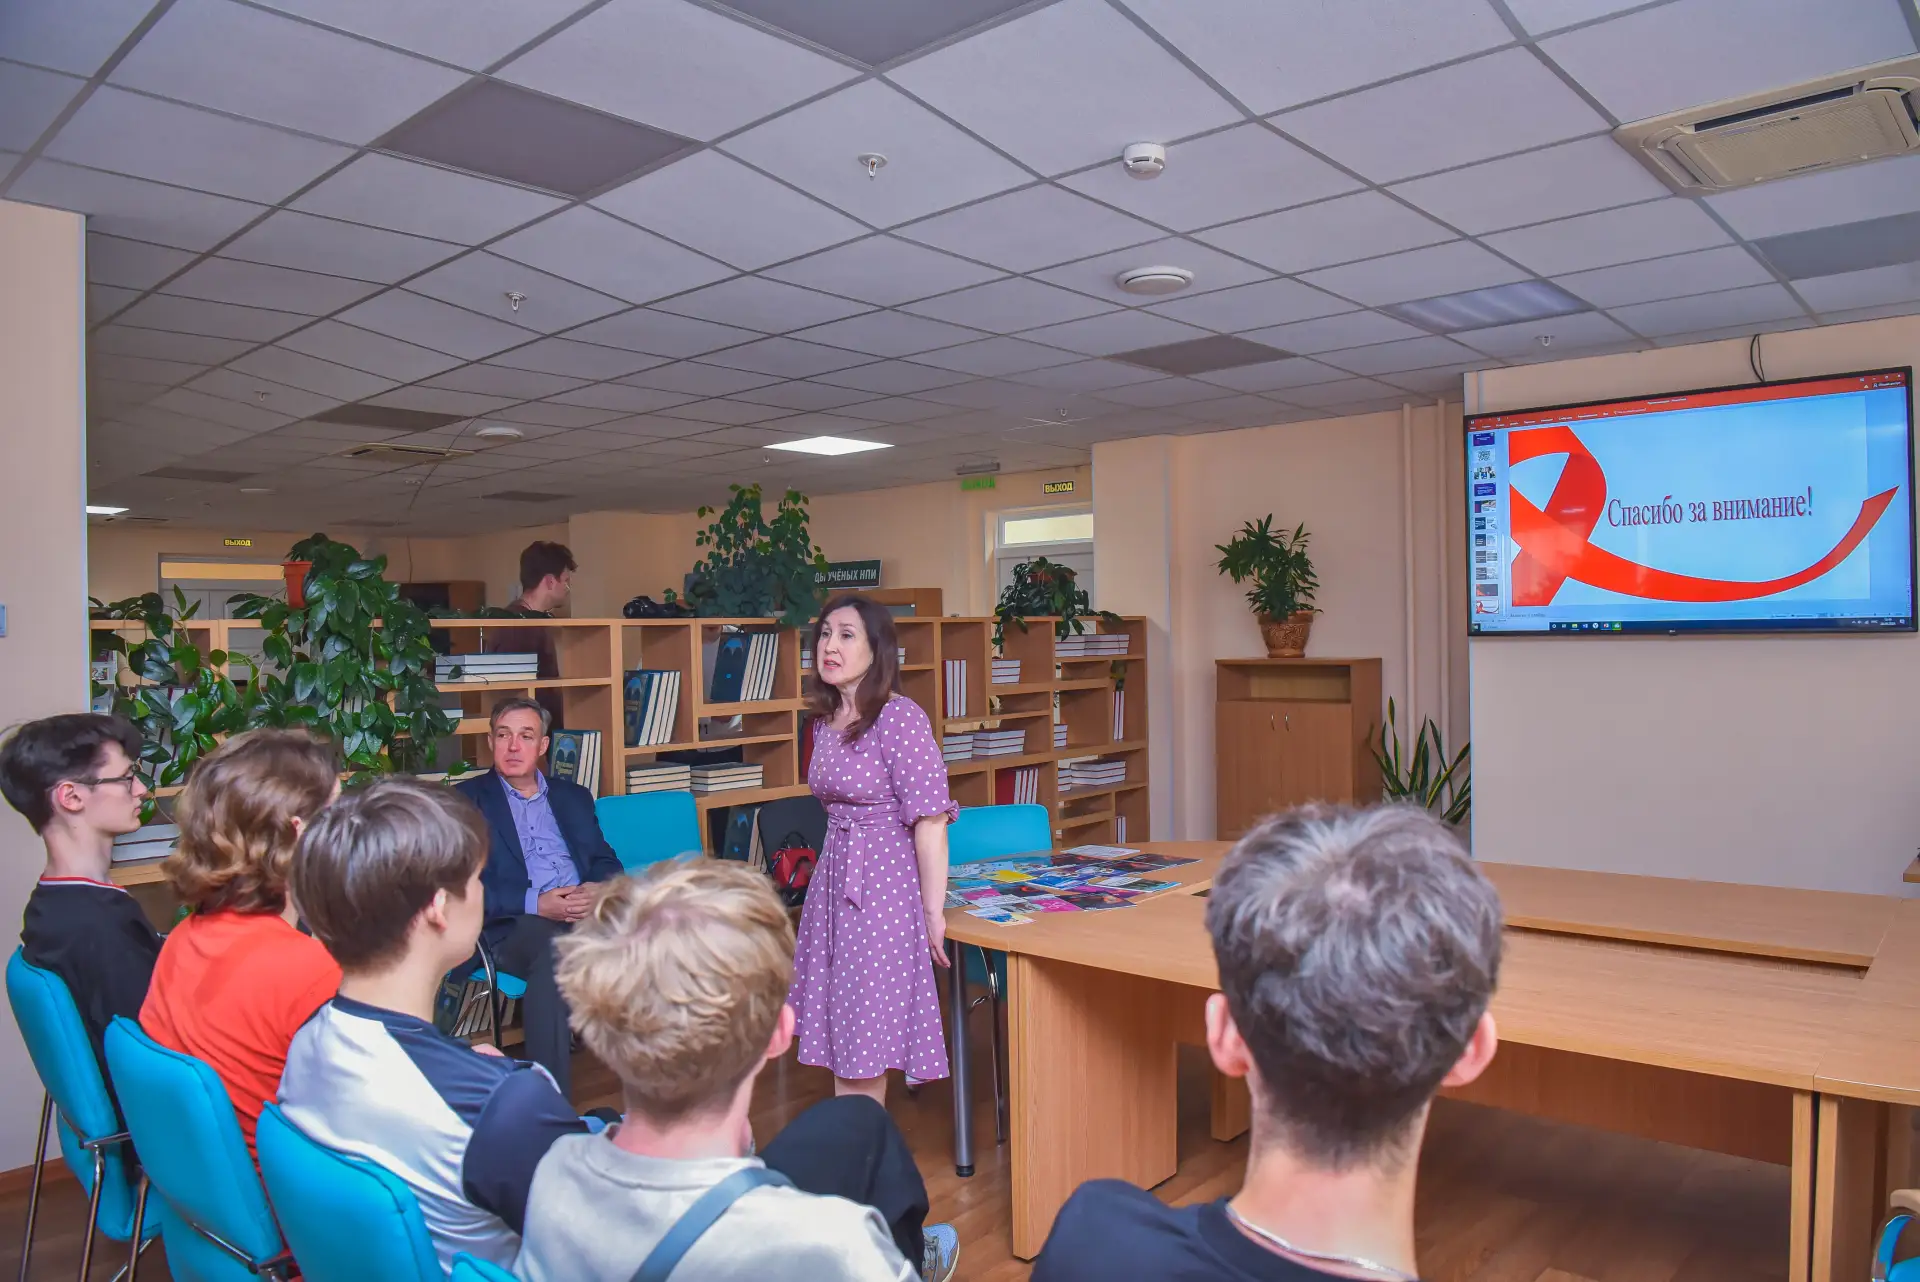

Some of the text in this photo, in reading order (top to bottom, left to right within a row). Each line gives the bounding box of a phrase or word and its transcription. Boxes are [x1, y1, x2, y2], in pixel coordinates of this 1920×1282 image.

[1044, 482, 1073, 493] ВЫХОД
[1608, 485, 1813, 527] Спасибо за внимание!
[827, 567, 859, 581] УЧЁНЫХ
[860, 568, 877, 580] НПИ
